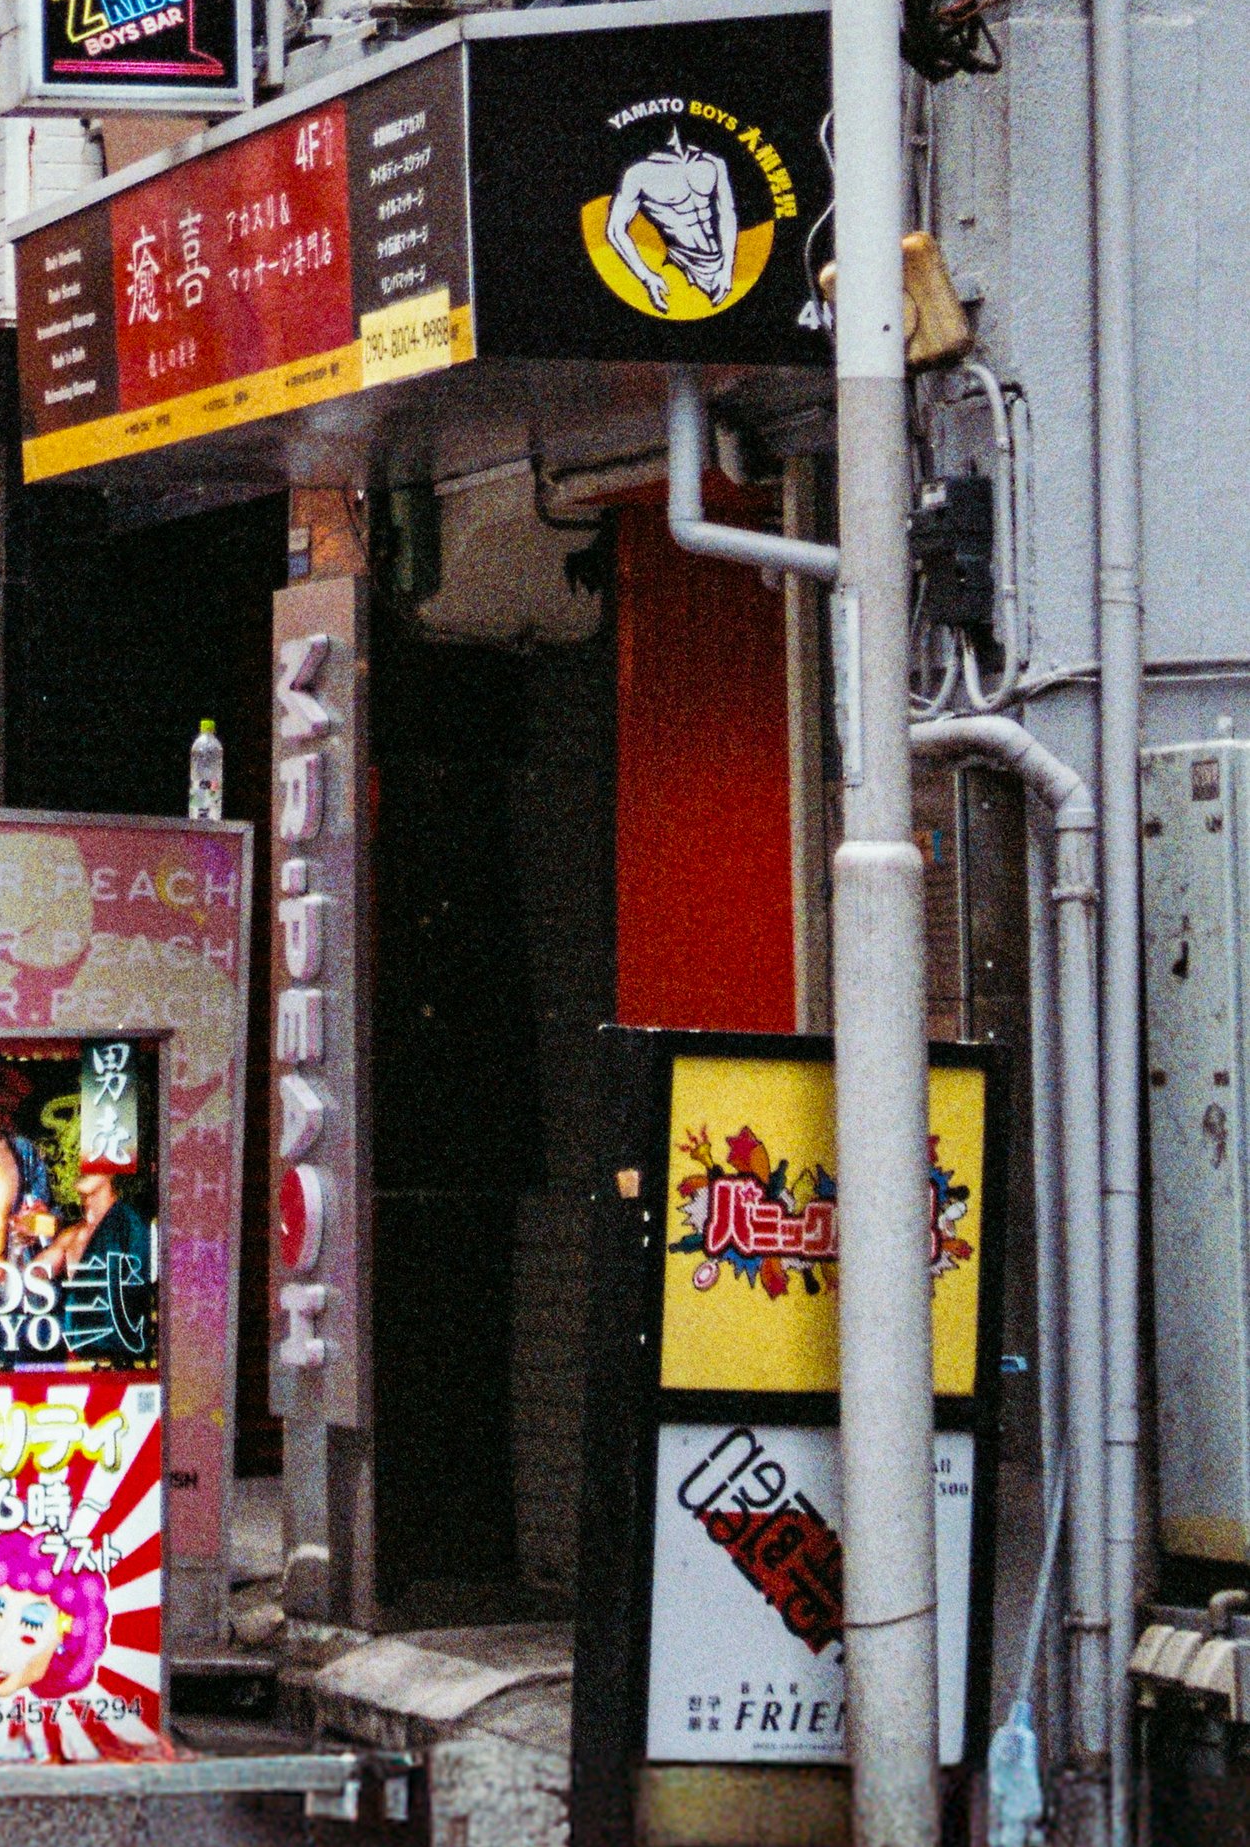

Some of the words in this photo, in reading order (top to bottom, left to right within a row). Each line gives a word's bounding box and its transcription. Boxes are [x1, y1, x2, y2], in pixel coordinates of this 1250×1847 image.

[84, 23, 141, 57] BOYS
[142, 6, 185, 36] BAR
[608, 98, 685, 130] YAMATO
[688, 100, 740, 132] BOYS
[295, 121, 321, 172] 4F
[39, 1532, 123, 1575] ラスト
[740, 1681, 799, 1696] BAR
